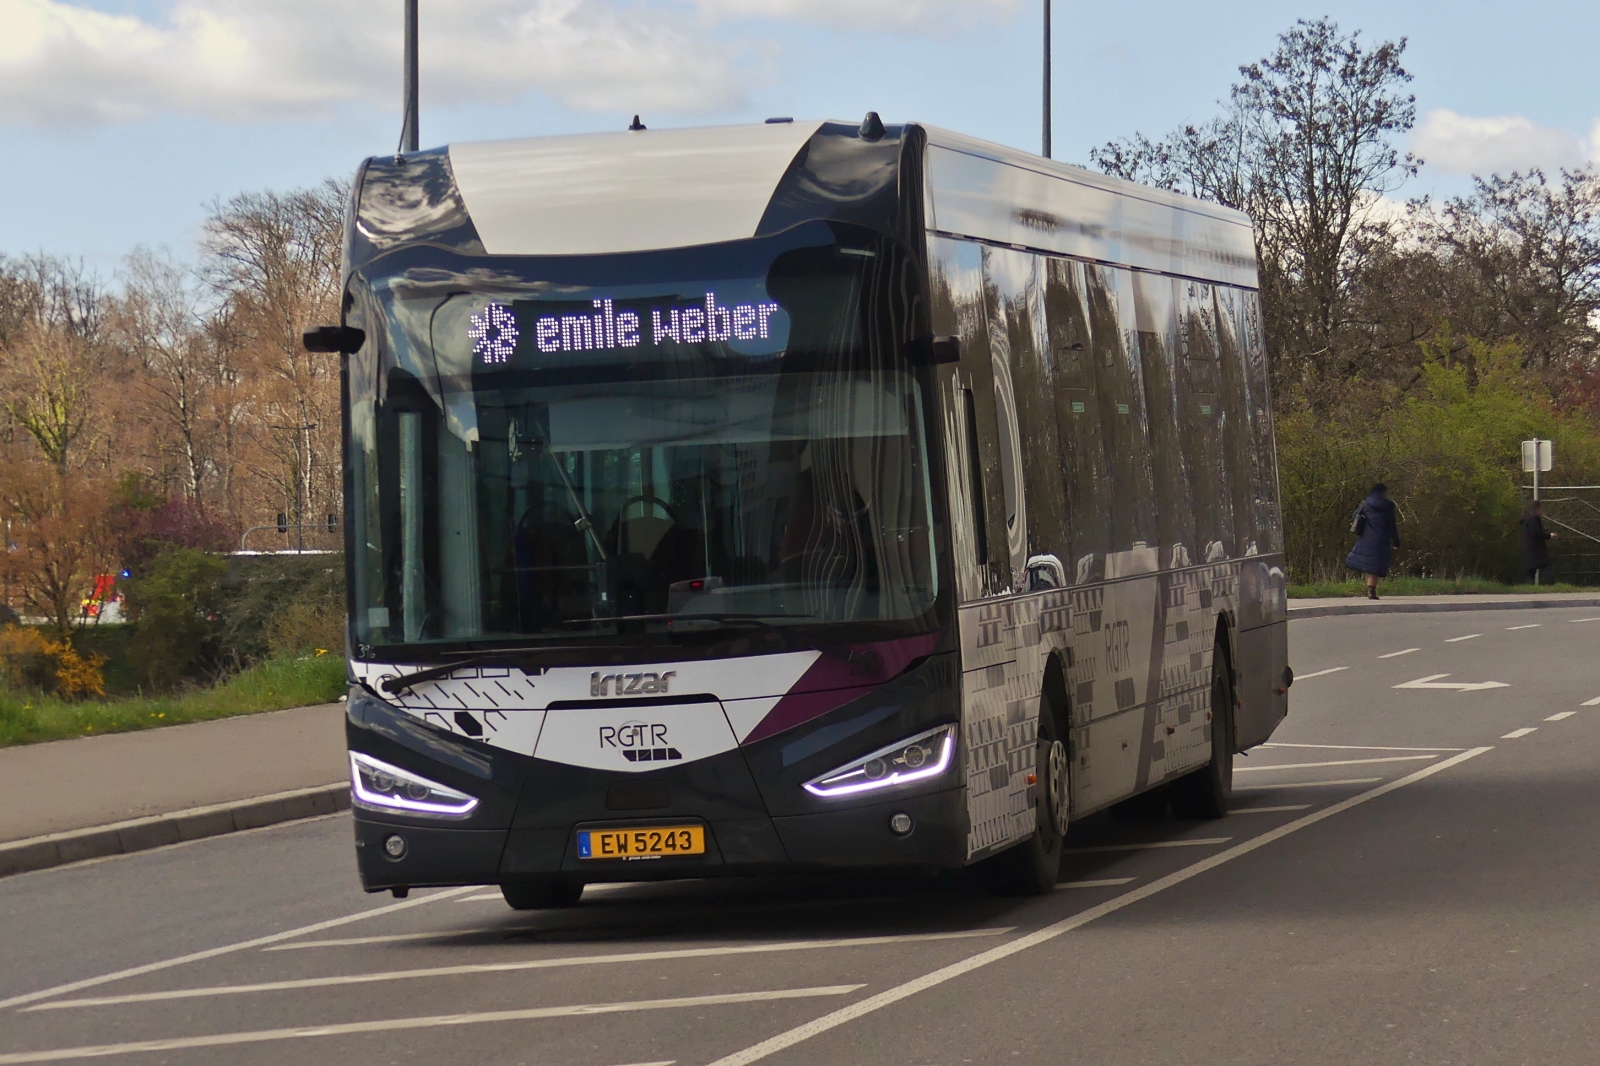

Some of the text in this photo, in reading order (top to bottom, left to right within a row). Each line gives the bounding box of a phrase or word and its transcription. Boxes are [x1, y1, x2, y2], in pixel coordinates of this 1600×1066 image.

[537, 292, 778, 353] emile weber
[1104, 620, 1130, 674] RGTR
[599, 723, 668, 749] RGTR
[634, 831, 692, 853] 5243
